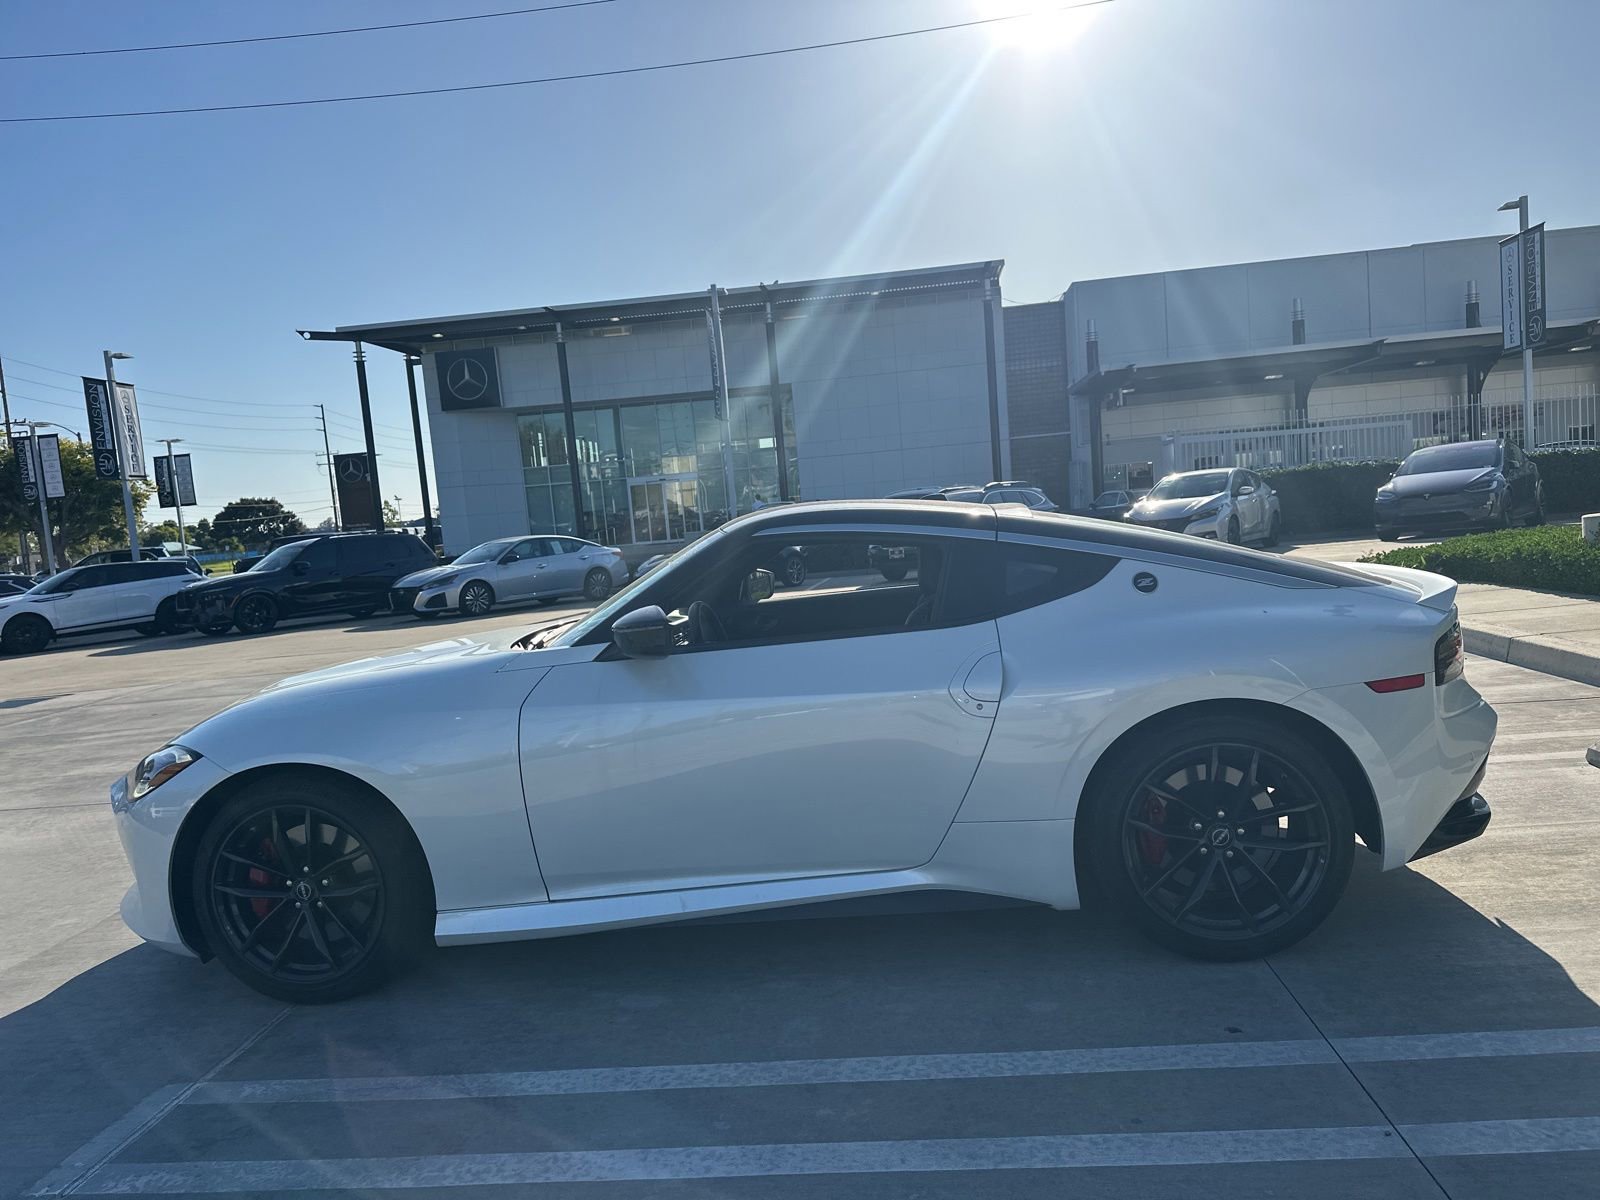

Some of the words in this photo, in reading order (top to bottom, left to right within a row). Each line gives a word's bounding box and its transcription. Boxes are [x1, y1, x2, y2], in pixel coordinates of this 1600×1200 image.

[1507, 265, 1515, 344] SERVICE
[1527, 234, 1537, 312] ENVISION
[88, 383, 106, 450] ENVISION
[124, 404, 138, 473] SERVICE
[17, 440, 29, 483] ENVISION
